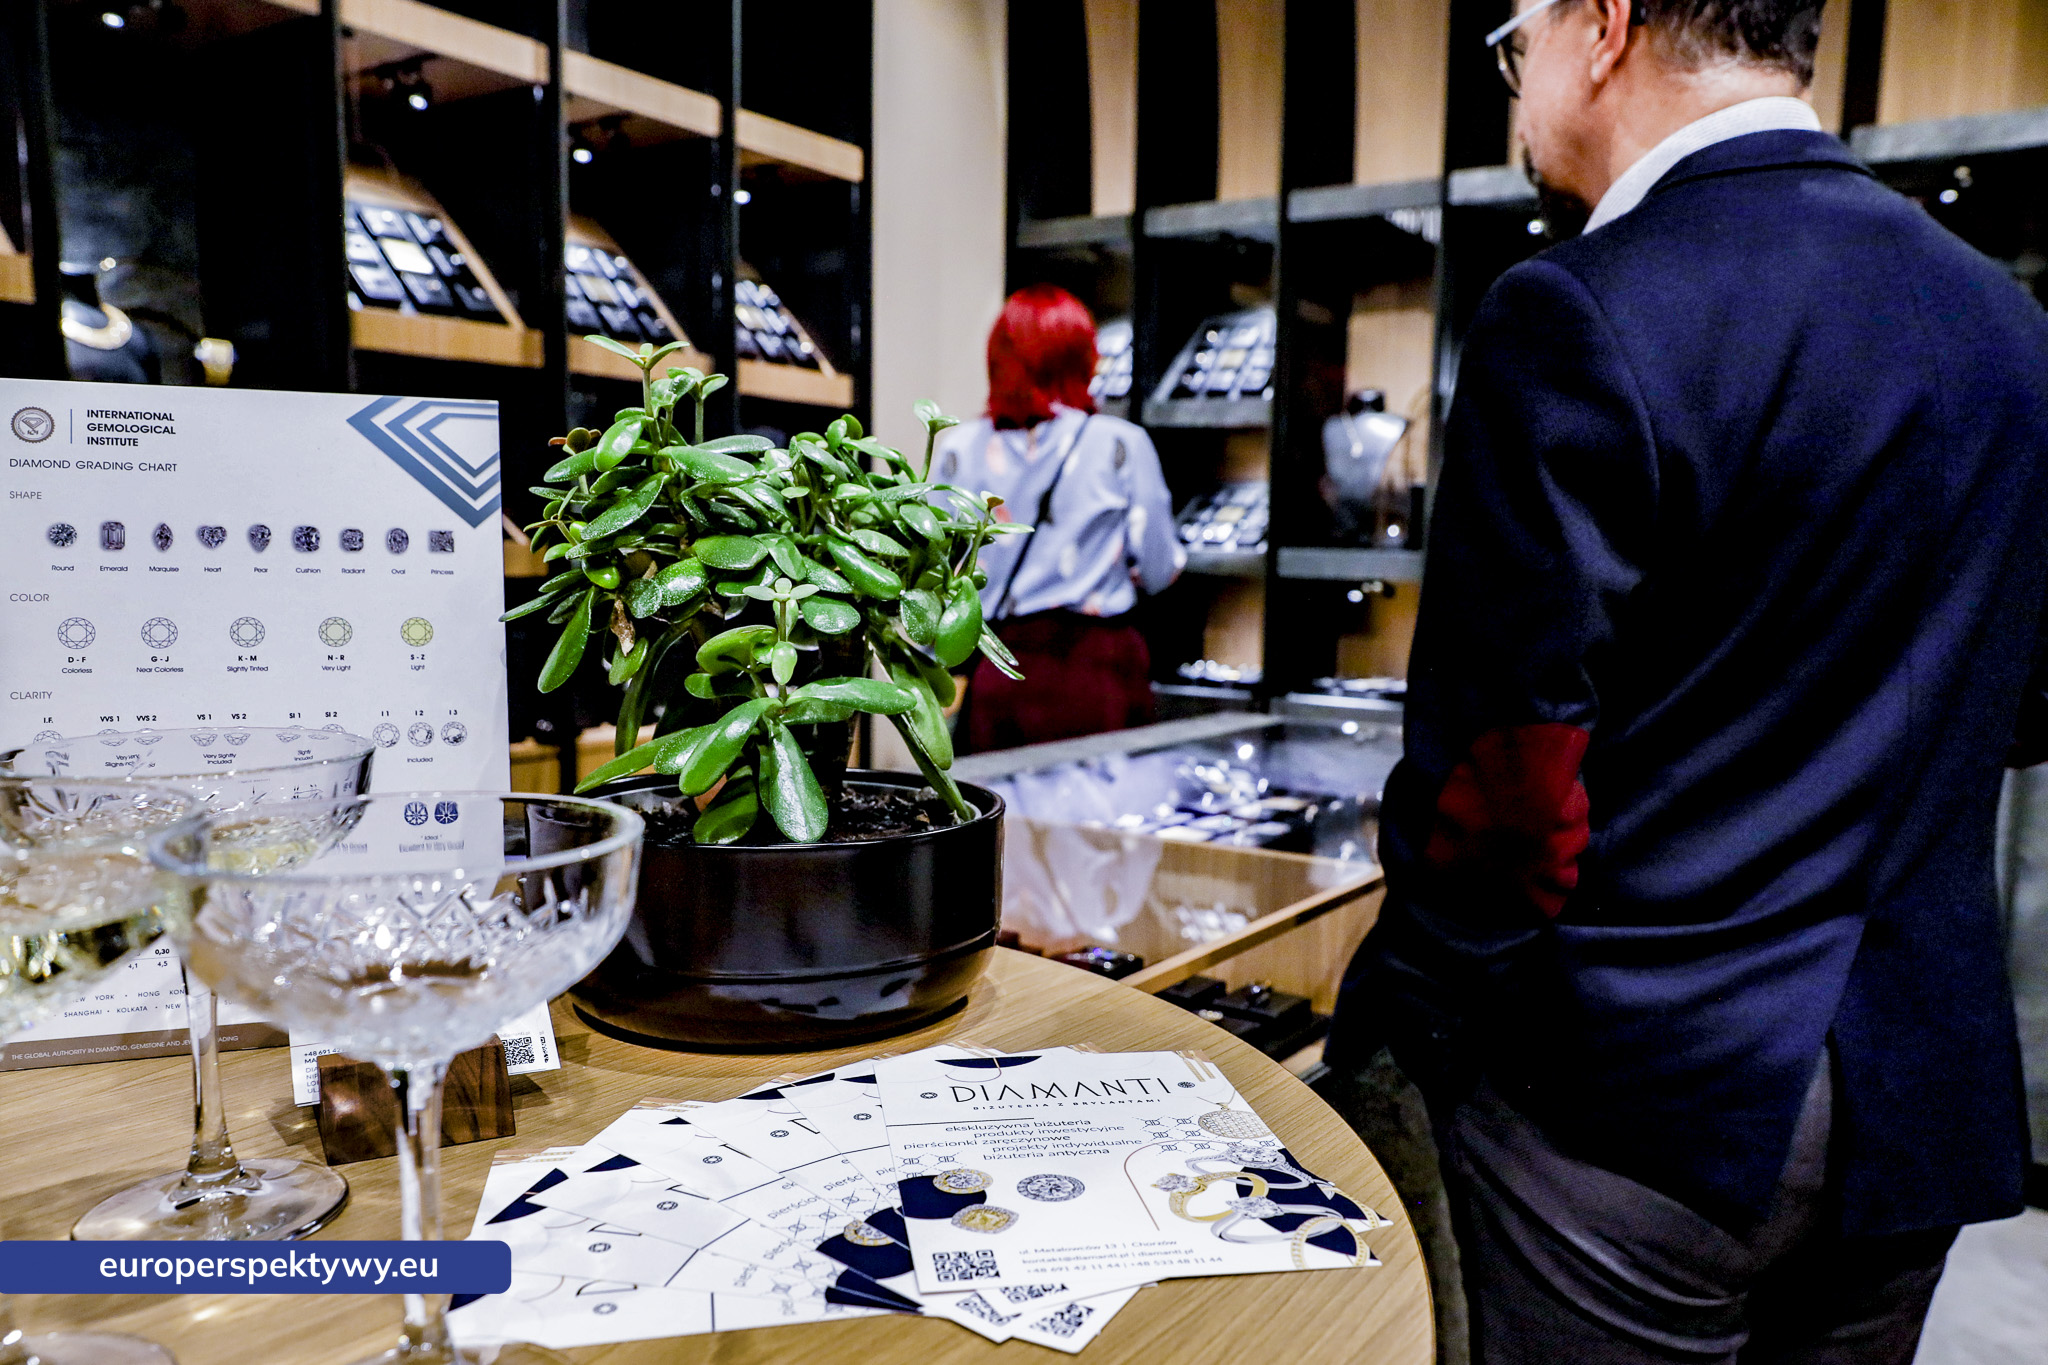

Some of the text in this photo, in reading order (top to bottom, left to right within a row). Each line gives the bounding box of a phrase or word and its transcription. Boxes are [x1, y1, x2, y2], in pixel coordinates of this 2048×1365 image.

[87, 409, 175, 422] INTERNATIONAL
[87, 423, 177, 435] GEMOLOGICAL
[87, 436, 139, 447] INSTITUTE
[9, 458, 178, 472] DIAMOND GRADING CHART
[9, 491, 42, 500] SHAPE
[9, 593, 50, 602] COLOR
[9, 691, 53, 700] CLARITY
[154, 948, 170, 956] 0,30
[64, 1009, 103, 1018] SHANGHAI
[117, 1006, 148, 1014] KOLKATA
[24, 1052, 51, 1060] GLOBAL
[52, 1049, 86, 1057] AUTHORITY
[130, 1042, 166, 1050] GEMSTONE
[949, 1077, 1171, 1103] DIAMANTI
[945, 1119, 1091, 1132] ekskluzywna biżuteria
[974, 1125, 1125, 1139] produkty inwestycyjne
[903, 1135, 1071, 1150] pierścionki zaręczynowe
[992, 1139, 1142, 1153] projekty indywidualne
[983, 1148, 1110, 1160] biżuteria antyczna
[767, 1196, 818, 1220] pierścio
